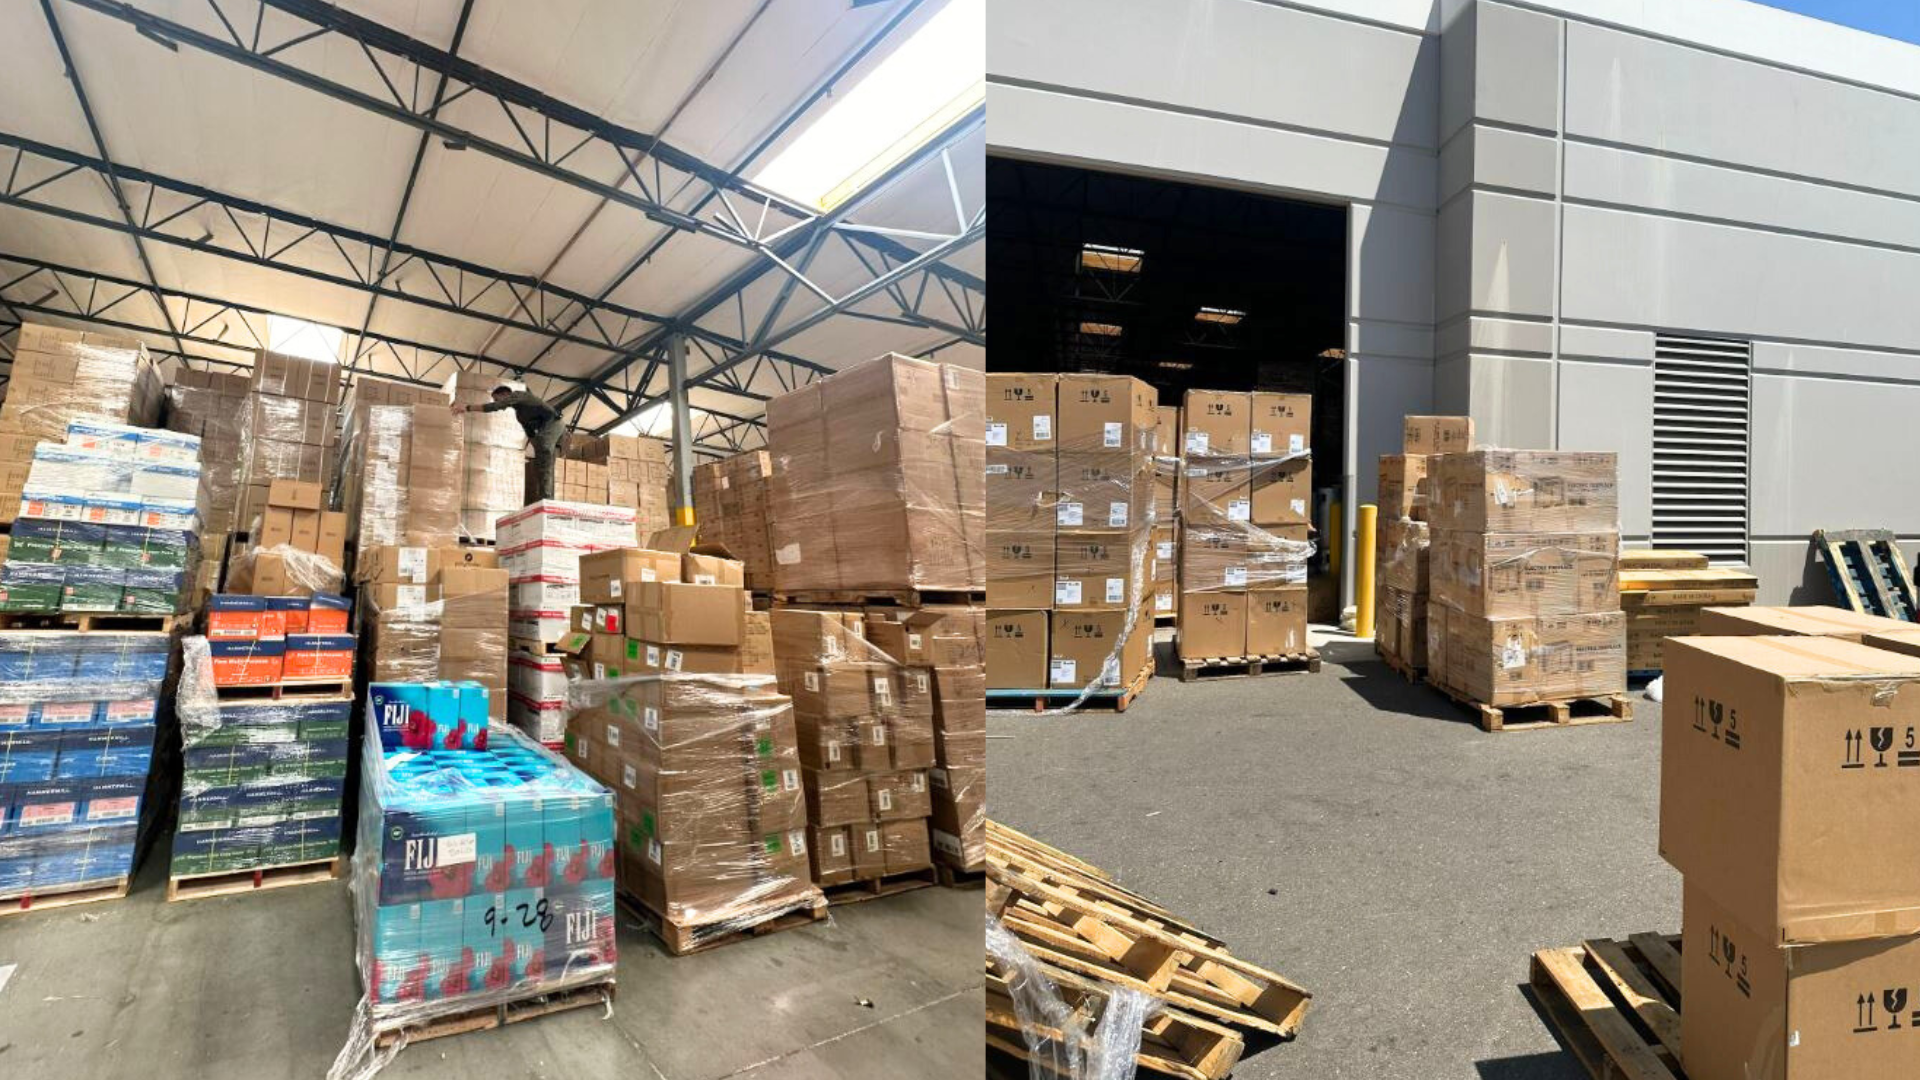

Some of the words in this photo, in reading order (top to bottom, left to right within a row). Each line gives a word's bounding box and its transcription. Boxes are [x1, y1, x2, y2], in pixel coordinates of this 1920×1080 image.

[383, 704, 410, 725] FIJI
[1730, 709, 1736, 730] 5
[1905, 727, 1915, 749] 5
[404, 838, 438, 870] FIJ
[517, 850, 532, 864] FIJI
[566, 910, 598, 944] FIJI
